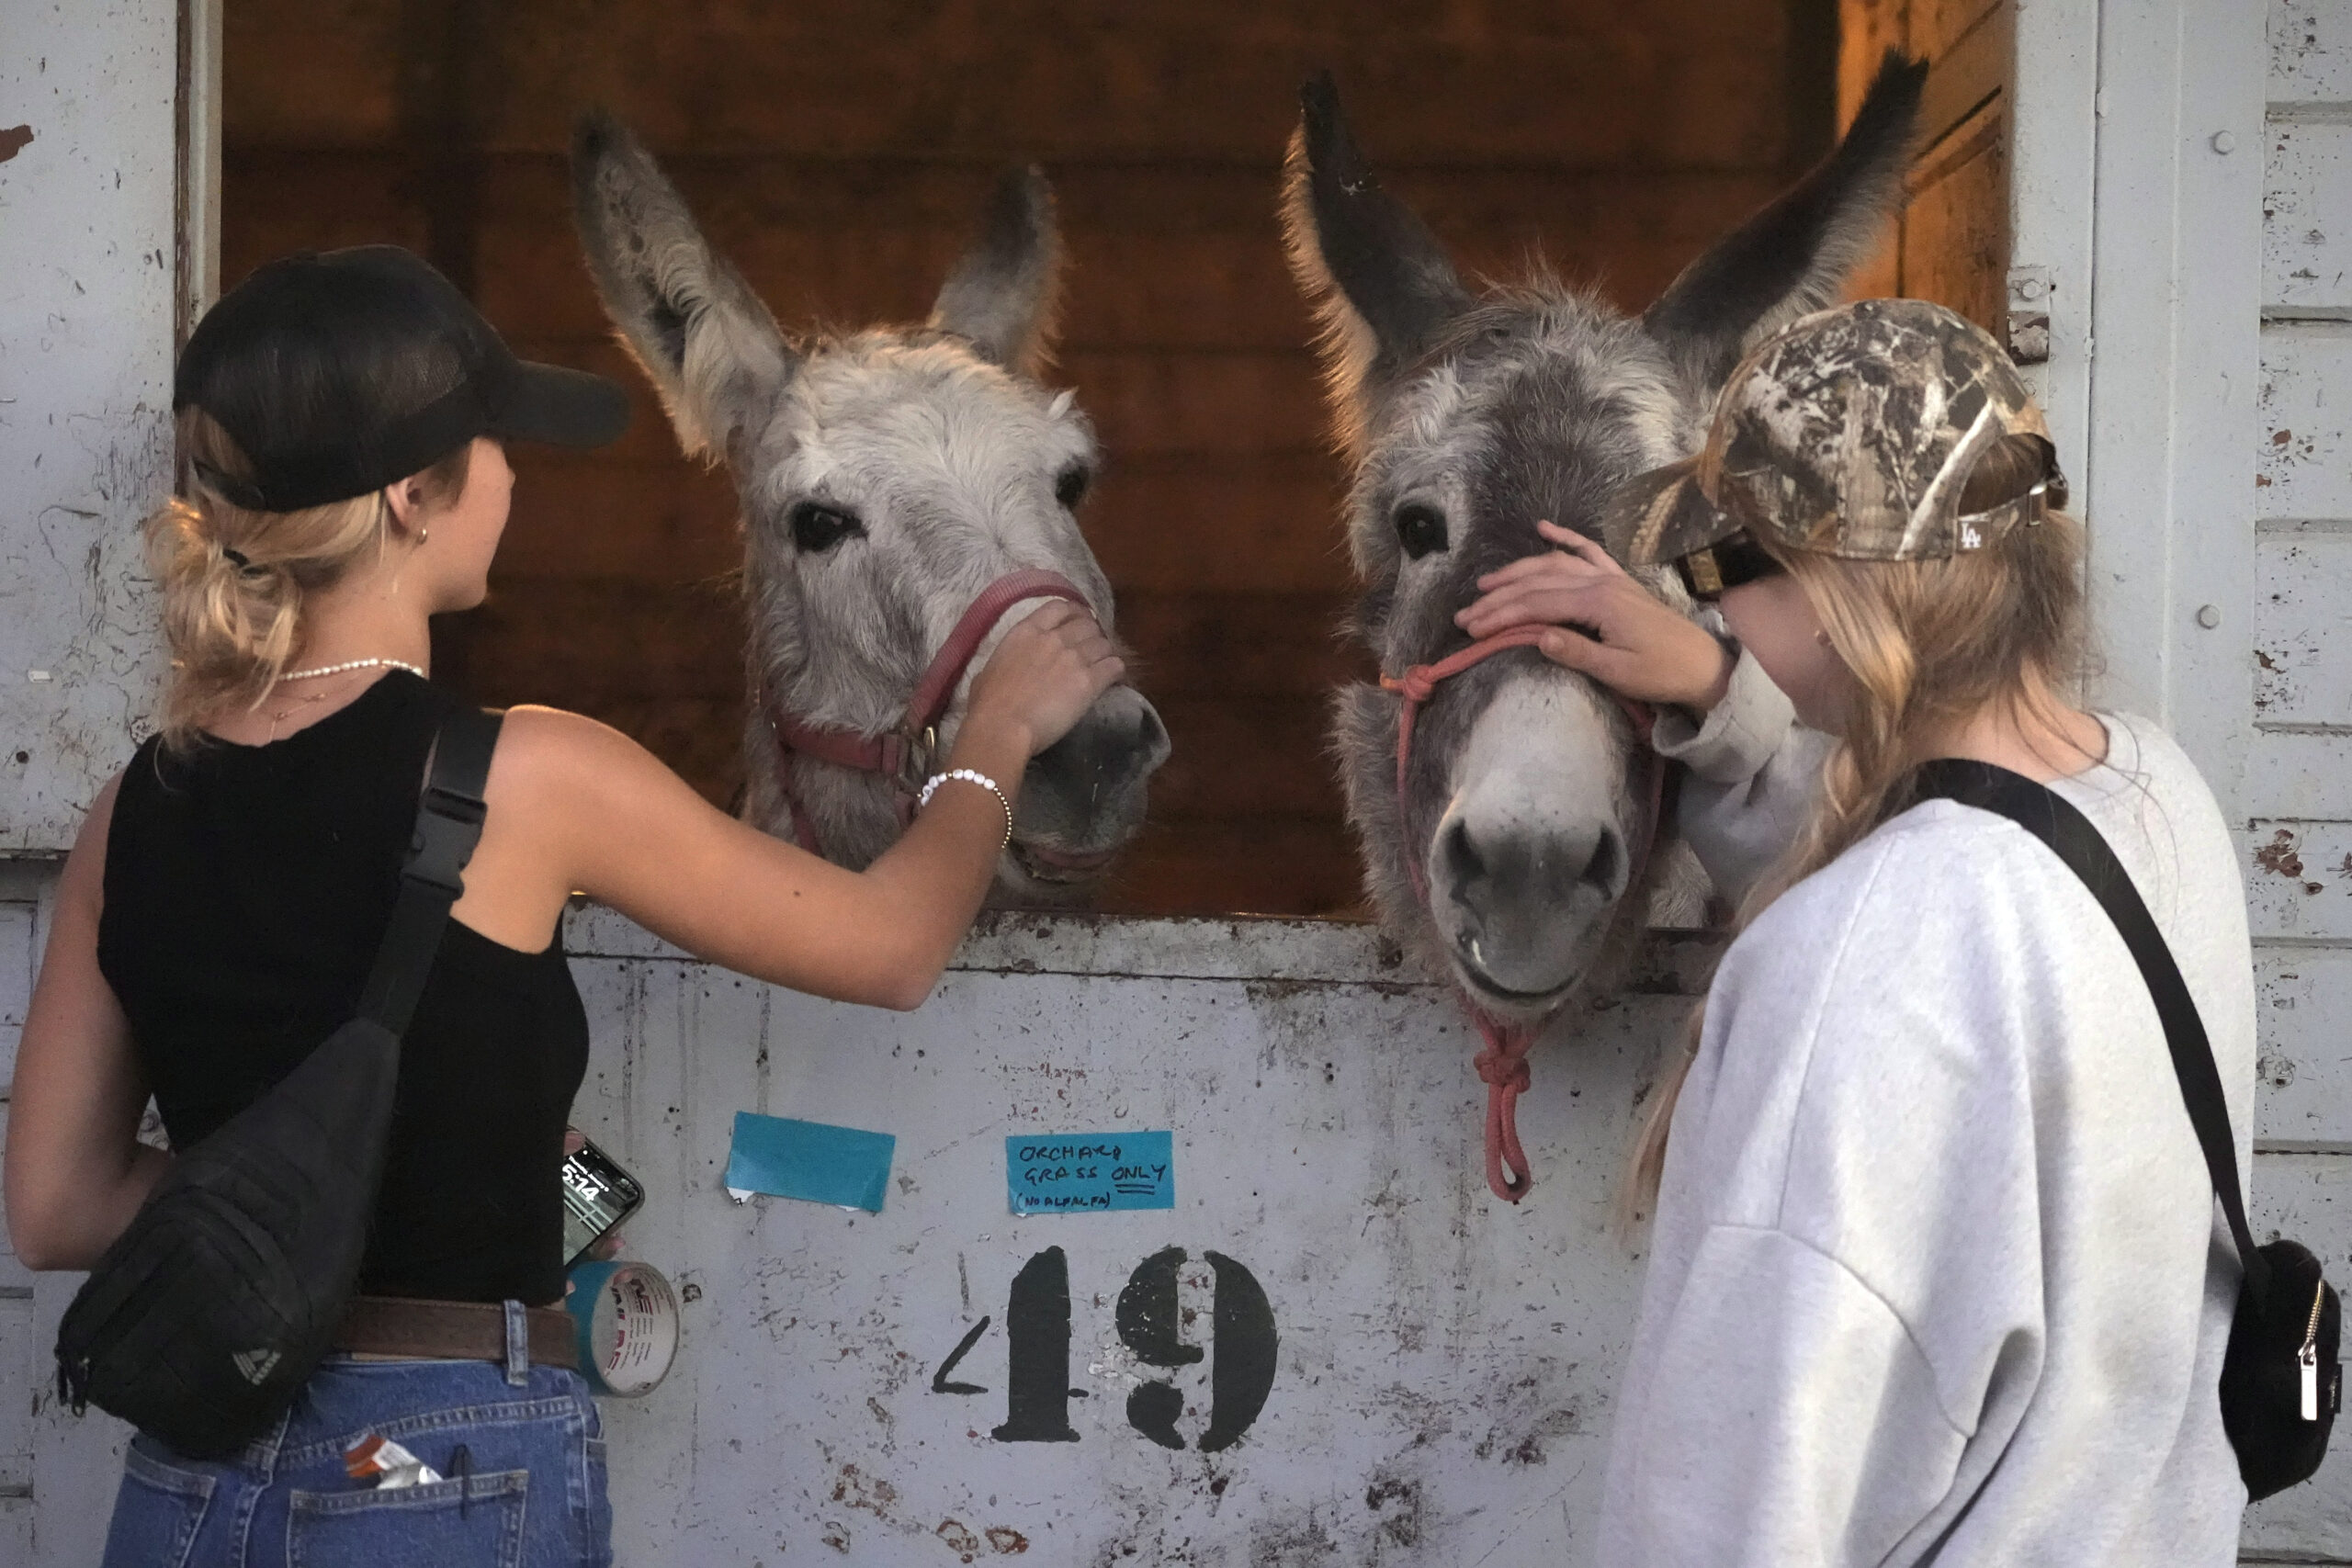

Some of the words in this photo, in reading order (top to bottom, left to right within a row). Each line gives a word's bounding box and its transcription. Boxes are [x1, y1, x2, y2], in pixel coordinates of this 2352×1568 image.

[1961, 523, 1982, 548] LA
[1019, 1144, 1122, 1162] ORCHARD
[561, 1163, 600, 1201] 5:14
[1023, 1166, 1098, 1186] GRASS
[1111, 1164, 1167, 1182] ONLY
[932, 1245, 1279, 1453] 49
